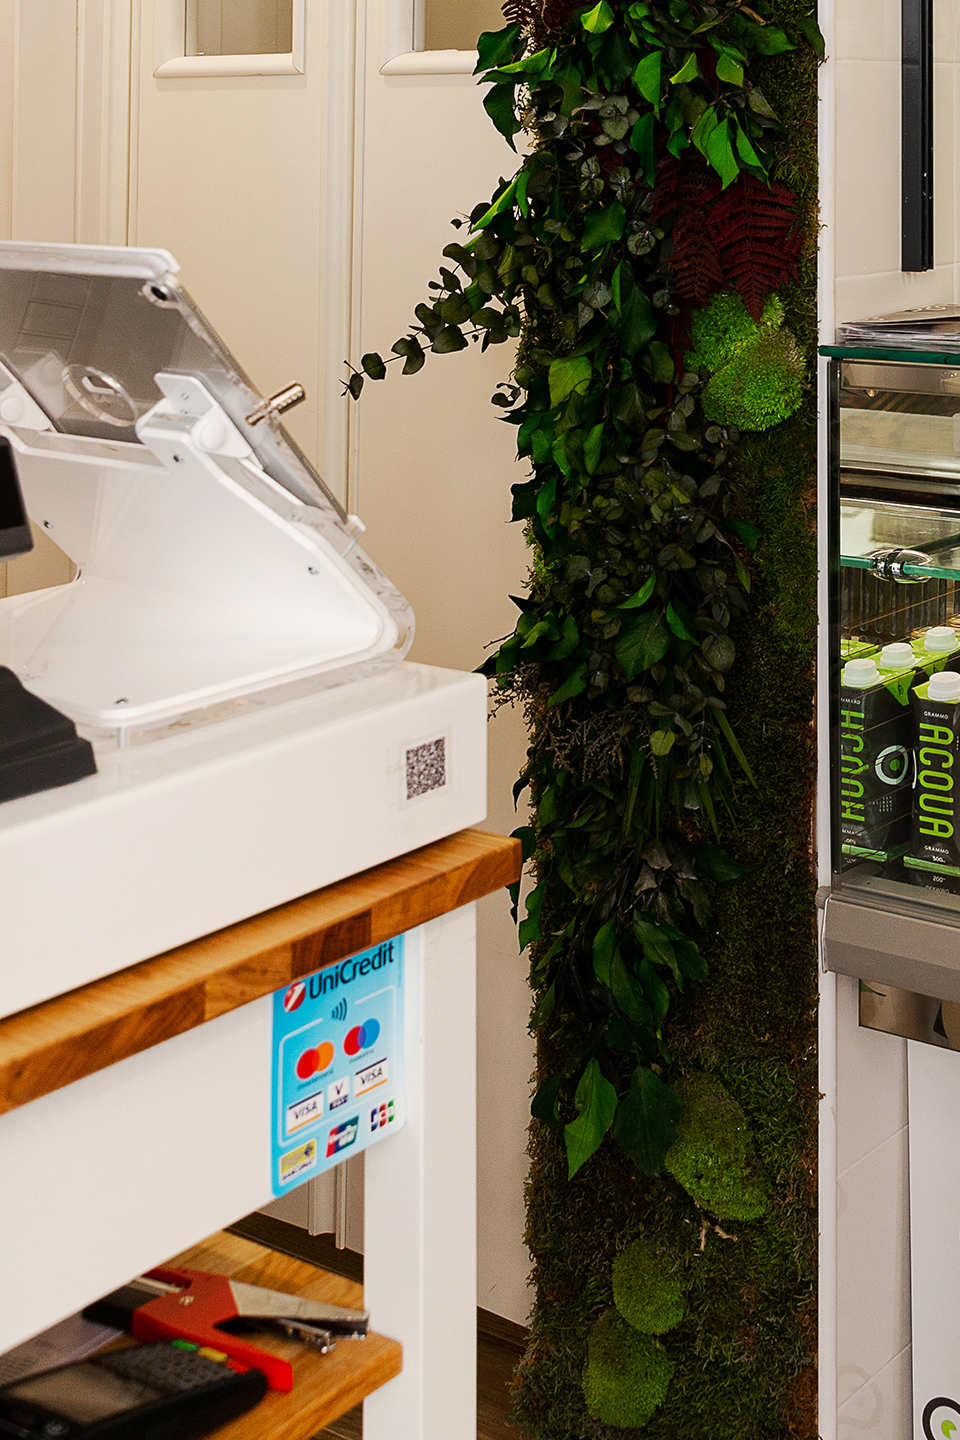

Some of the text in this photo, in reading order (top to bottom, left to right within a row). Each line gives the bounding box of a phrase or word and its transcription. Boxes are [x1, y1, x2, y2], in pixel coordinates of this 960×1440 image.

[923, 711, 949, 720] GRAMMO
[917, 722, 954, 838] ACQUA
[924, 845, 949, 855] GRAMMO
[309, 941, 395, 999] UniCredit
[360, 1066, 383, 1085] VISA
[293, 1100, 318, 1120] VISA
